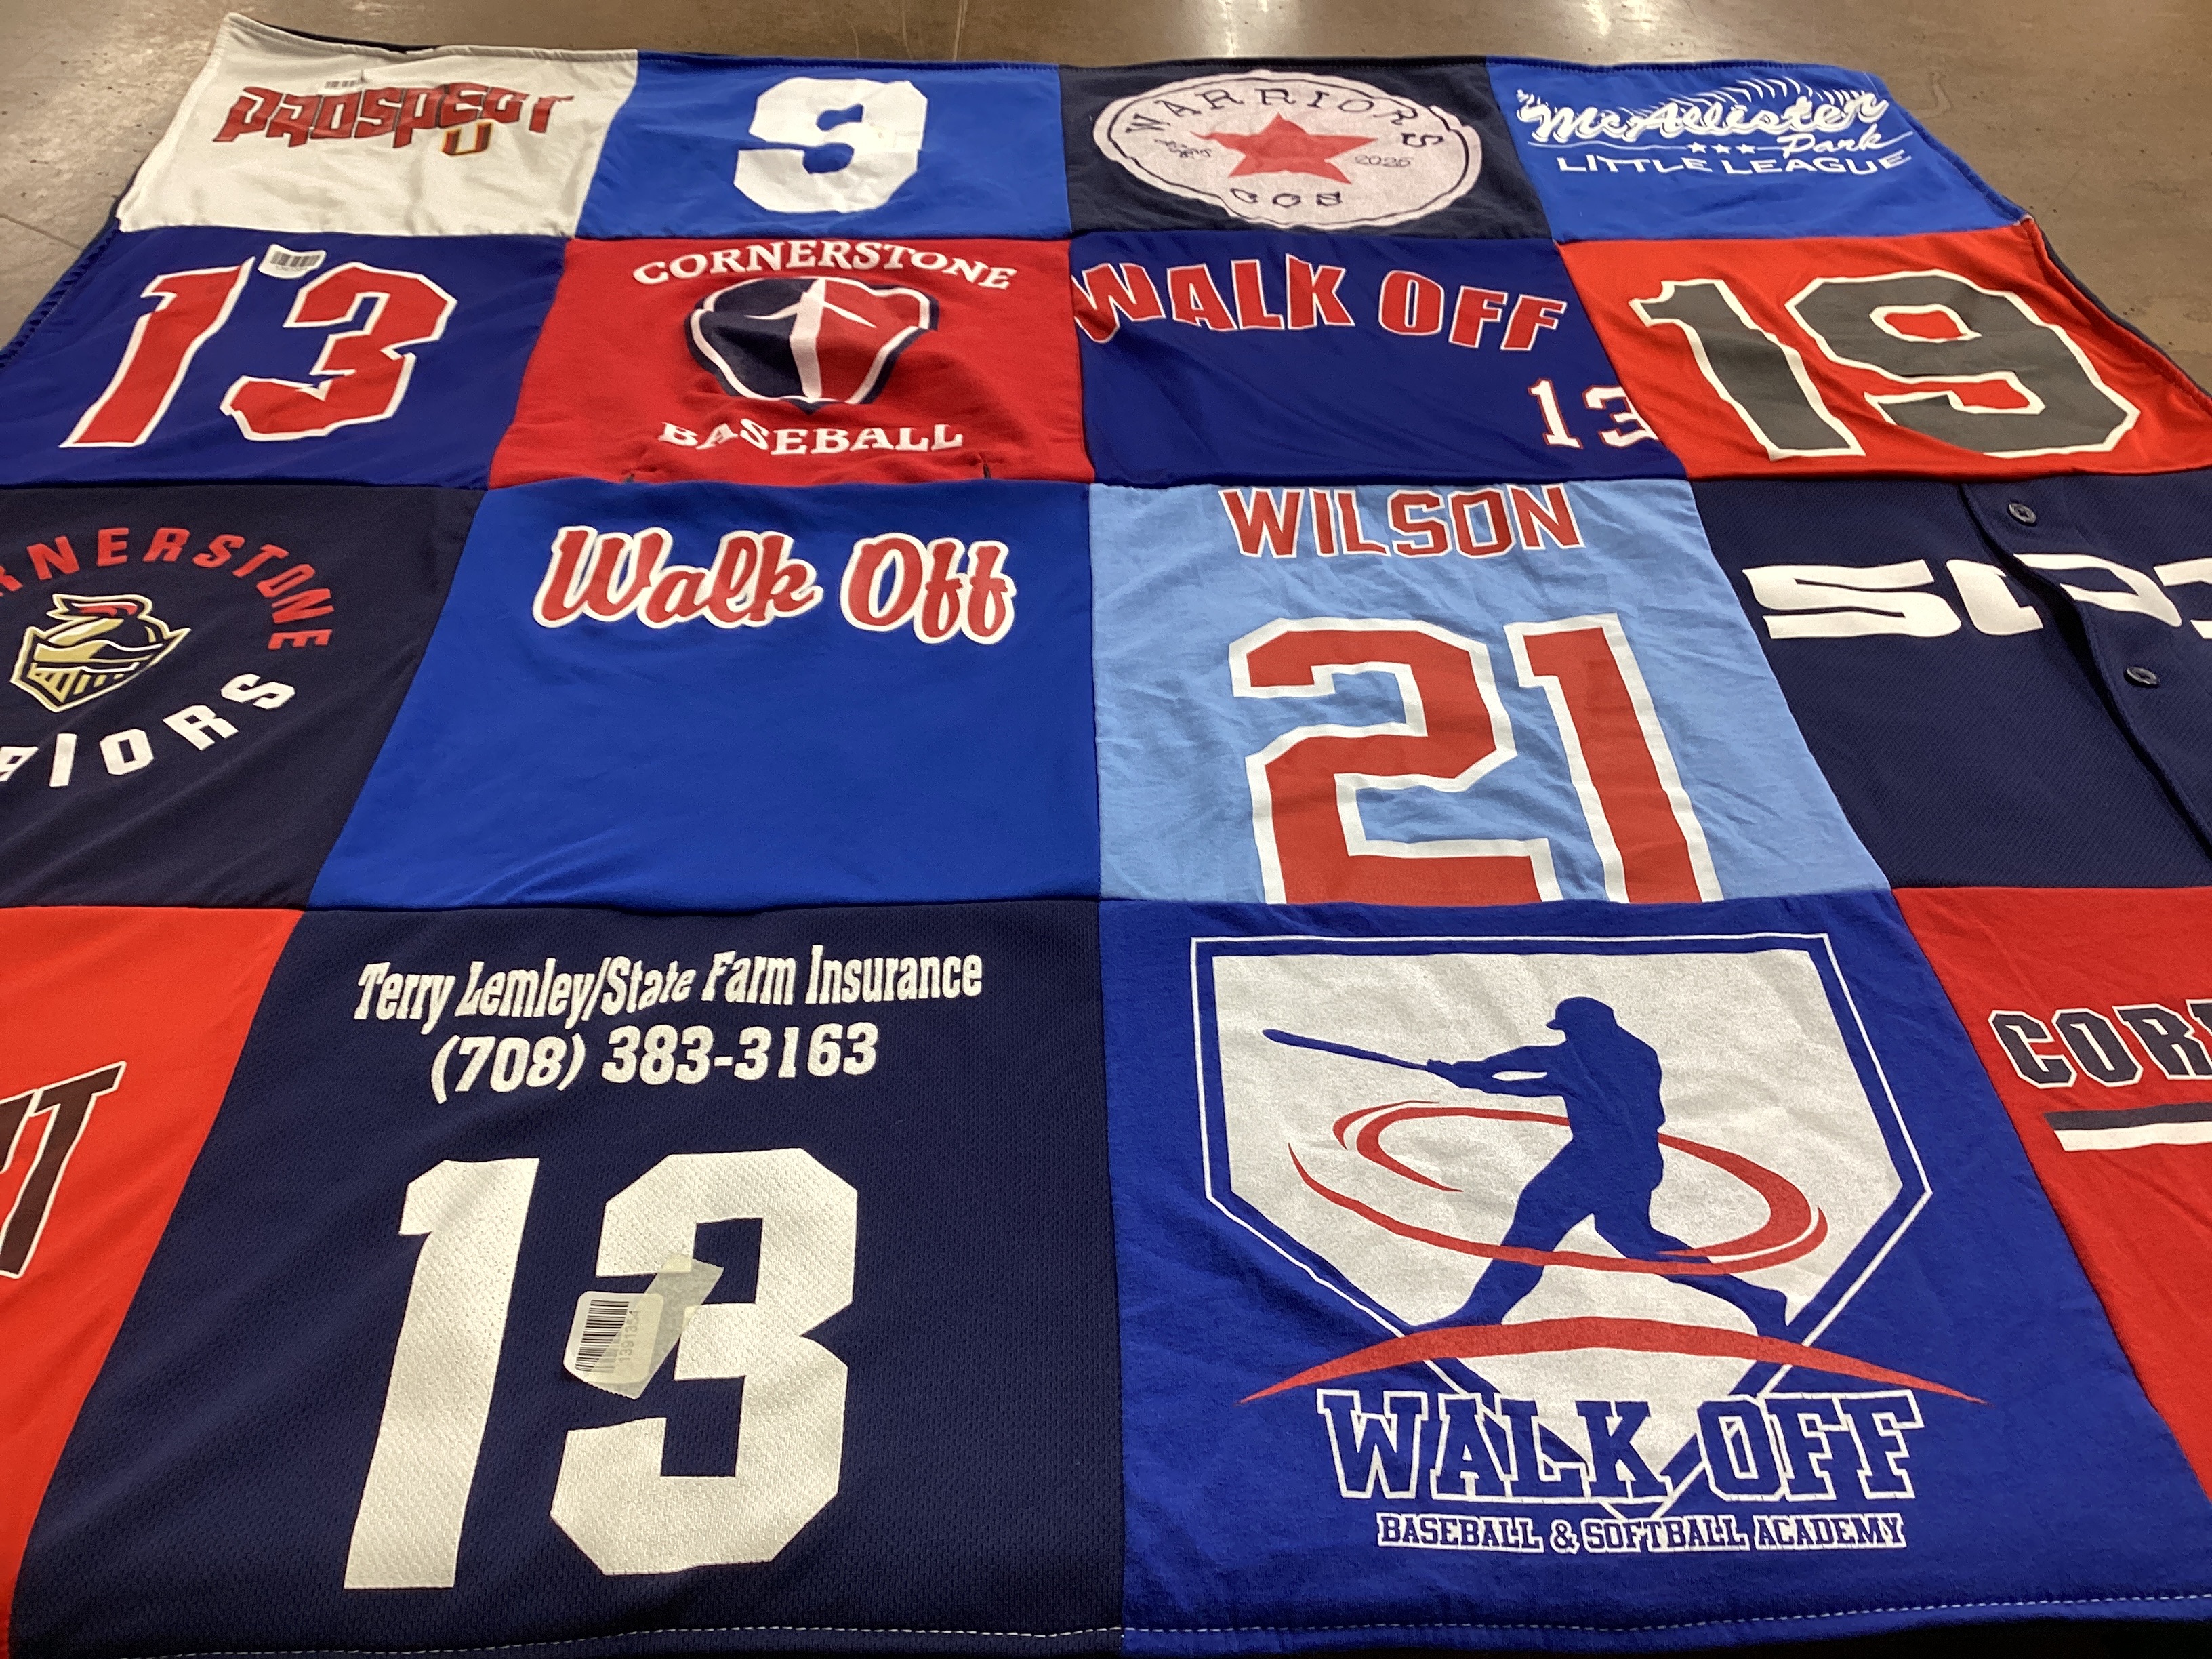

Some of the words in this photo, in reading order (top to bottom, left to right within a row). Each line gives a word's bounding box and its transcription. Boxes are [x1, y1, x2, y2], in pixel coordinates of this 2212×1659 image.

[213, 82, 574, 148] PROSPECT
[441, 121, 492, 156] U
[733, 77, 928, 214] 9
[1124, 87, 1444, 150] WARRIORS
[1774, 124, 1898, 159] Park
[1557, 154, 1713, 174] LITTLE
[1721, 149, 1912, 176] LEAGUE
[632, 240, 1018, 291] CORNERSTONE
[1071, 253, 1355, 344] WALK
[1377, 270, 1568, 352] OFF
[59, 257, 458, 448] 13
[1628, 269, 2142, 462] 19
[657, 418, 964, 456] BASEBALL
[1528, 377, 1660, 450] 13
[1218, 483, 1586, 558] WILSON
[532, 525, 823, 629] Walk
[840, 532, 1017, 645] Off
[1229, 613, 1725, 905] 21
[353, 962, 456, 1035] Terry
[454, 956, 697, 1030] Lemley/State
[701, 951, 795, 1005] Farm
[804, 944, 983, 1005] Insurance
[430, 1033, 586, 1105] (708)
[601, 1022, 880, 1086] 383-3163
[344, 1147, 858, 1589] 13
[618, 1310, 641, 1363] 1391354
[1316, 1388, 1674, 1505] WALK
[1694, 1389, 1925, 1502] OFF
[1376, 1512, 1544, 1553] BASEBALL
[1551, 1519, 1580, 1555] &
[1580, 1515, 1750, 1554] SOFTBALL
[1752, 1513, 1907, 1551] ACADEMY
